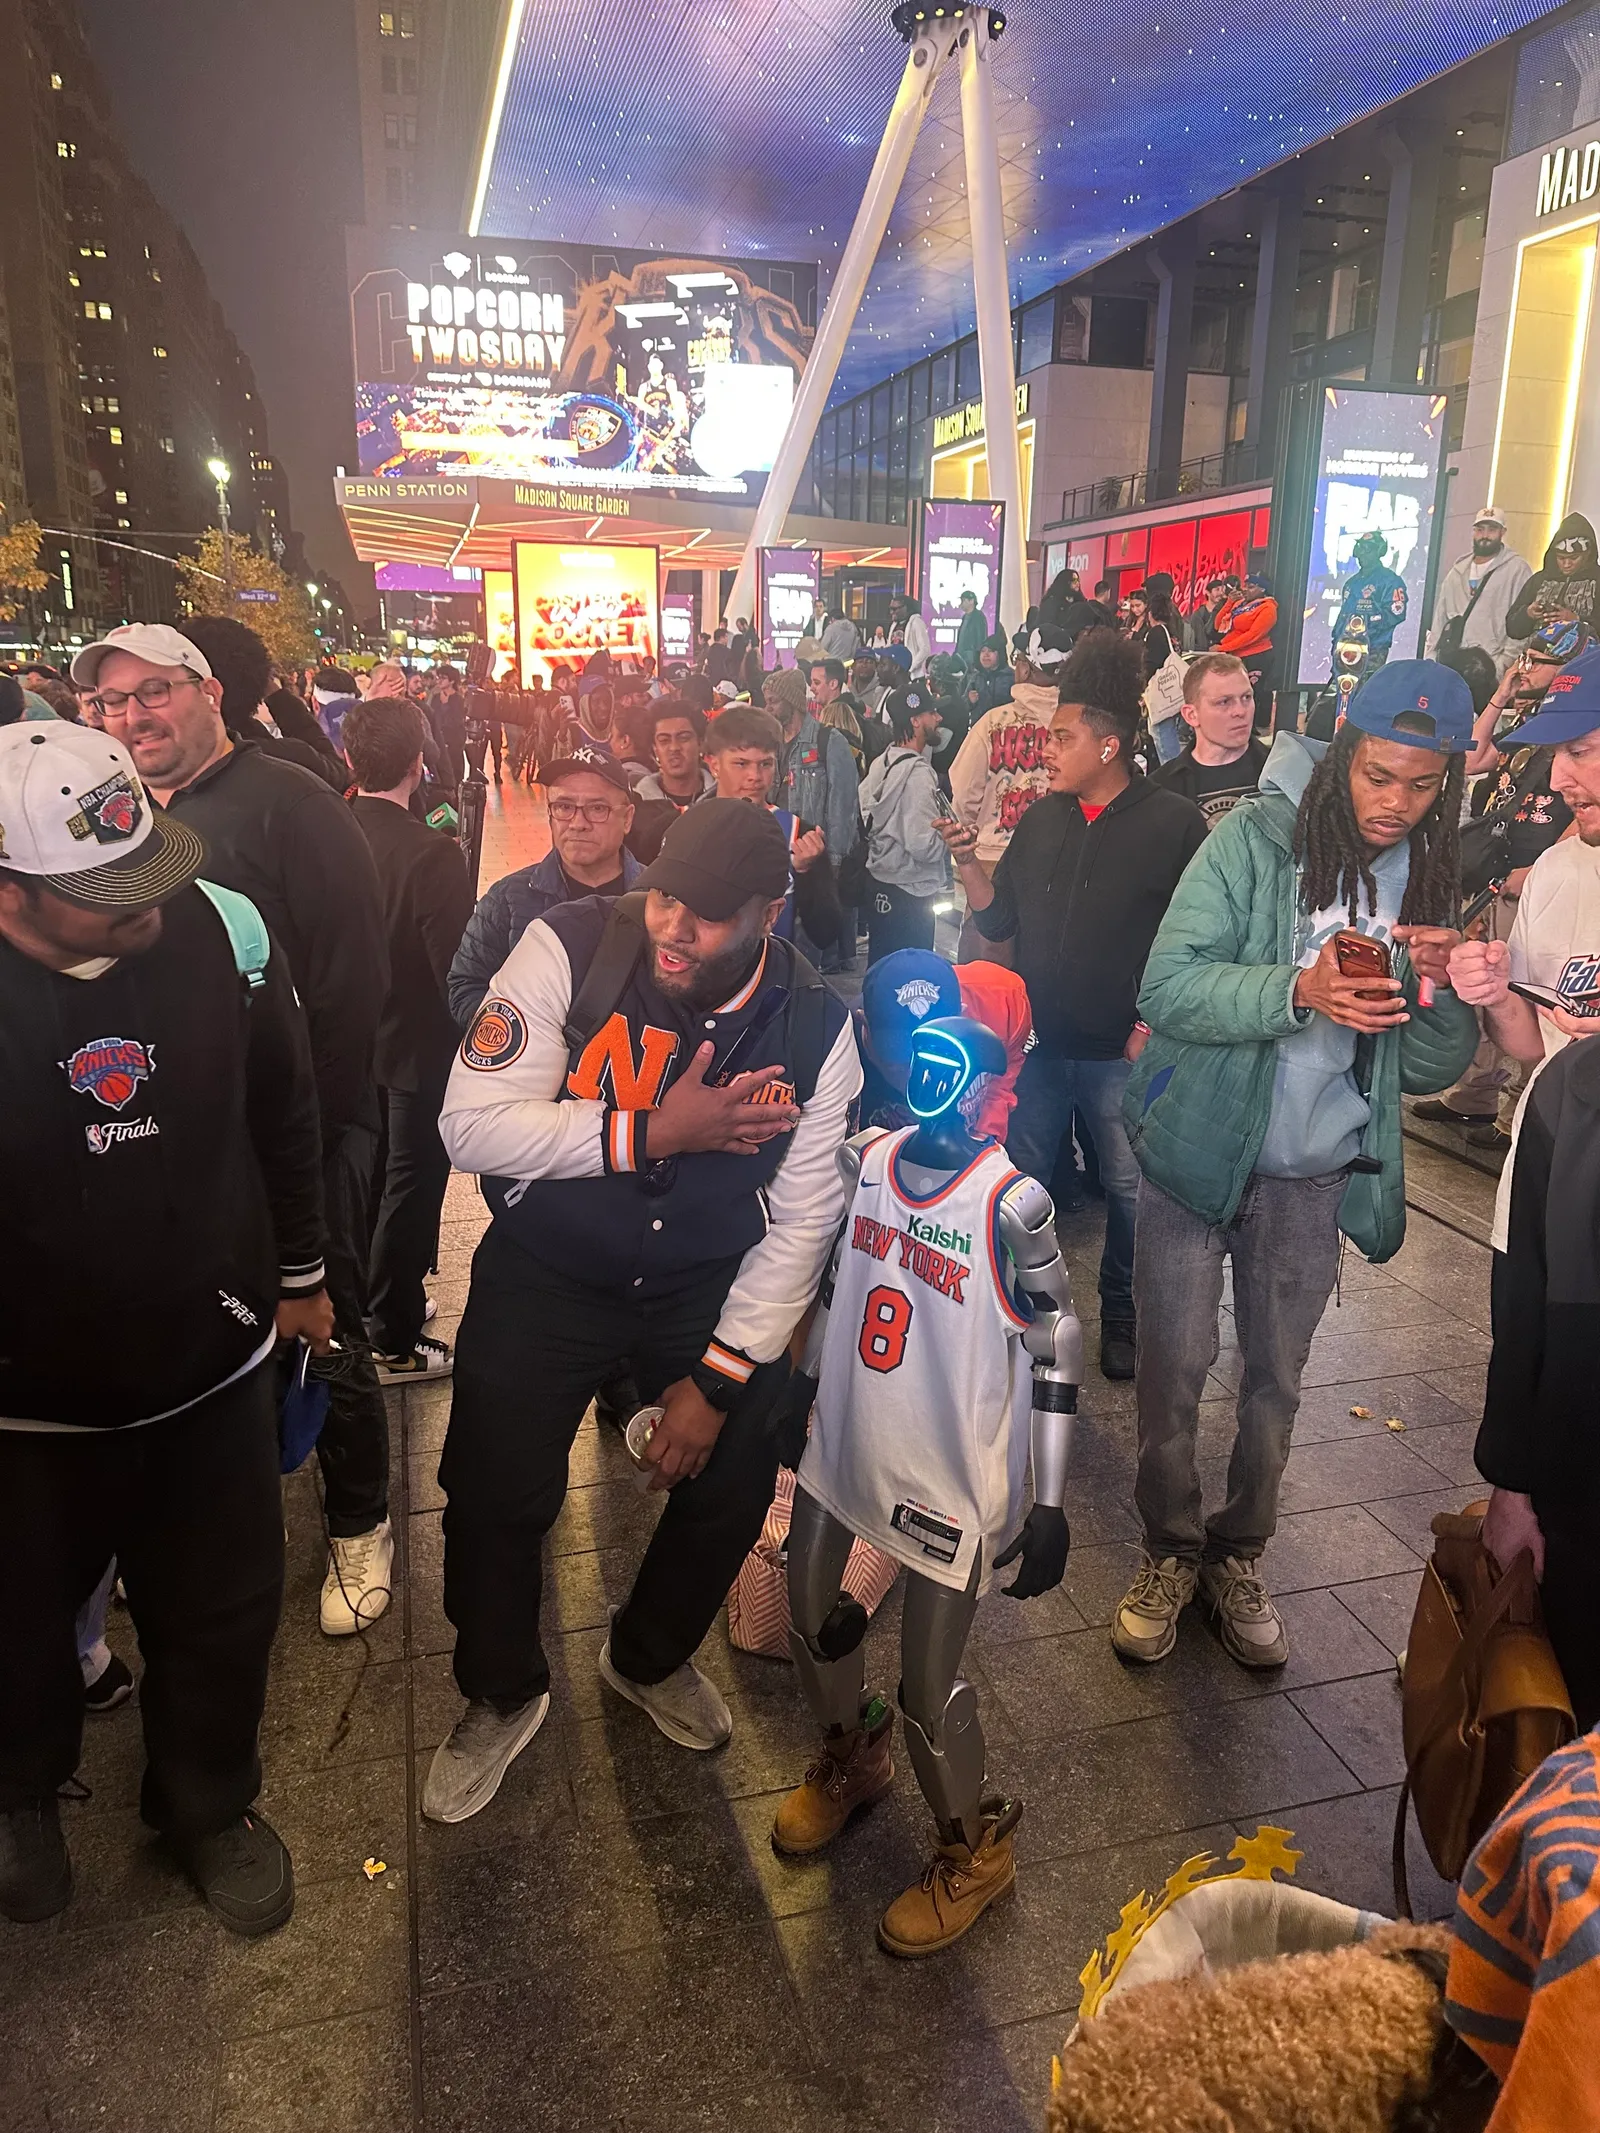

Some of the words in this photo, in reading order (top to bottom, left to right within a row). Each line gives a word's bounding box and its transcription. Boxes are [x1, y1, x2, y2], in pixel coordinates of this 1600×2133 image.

[1535, 140, 1600, 217] MAD
[407, 282, 564, 334] POPCORN
[406, 324, 566, 372] TWOSDAY
[933, 409, 965, 448] MADISON
[344, 484, 391, 498] PENN
[396, 483, 469, 497] STATION
[514, 484, 557, 508] MADISON
[559, 490, 594, 514] SQUARE
[596, 495, 630, 517] GARDEN
[1417, 695, 1429, 710] 5
[572, 747, 595, 764] NY
[988, 722, 1048, 775] HEA
[80, 793, 98, 810] NBA
[900, 984, 938, 1000] KNICKS
[500, 1004, 517, 1024] YORK
[477, 1023, 505, 1045] KNICKS
[71, 1041, 148, 1083] KNICKS
[466, 1049, 492, 1066] KNICKS
[567, 1012, 681, 1111] N
[95, 1115, 160, 1154] Finals
[906, 1213, 973, 1255] Kalshi
[851, 1214, 899, 1262] NEW
[898, 1230, 971, 1306] YORK
[857, 1283, 914, 1375] 8
